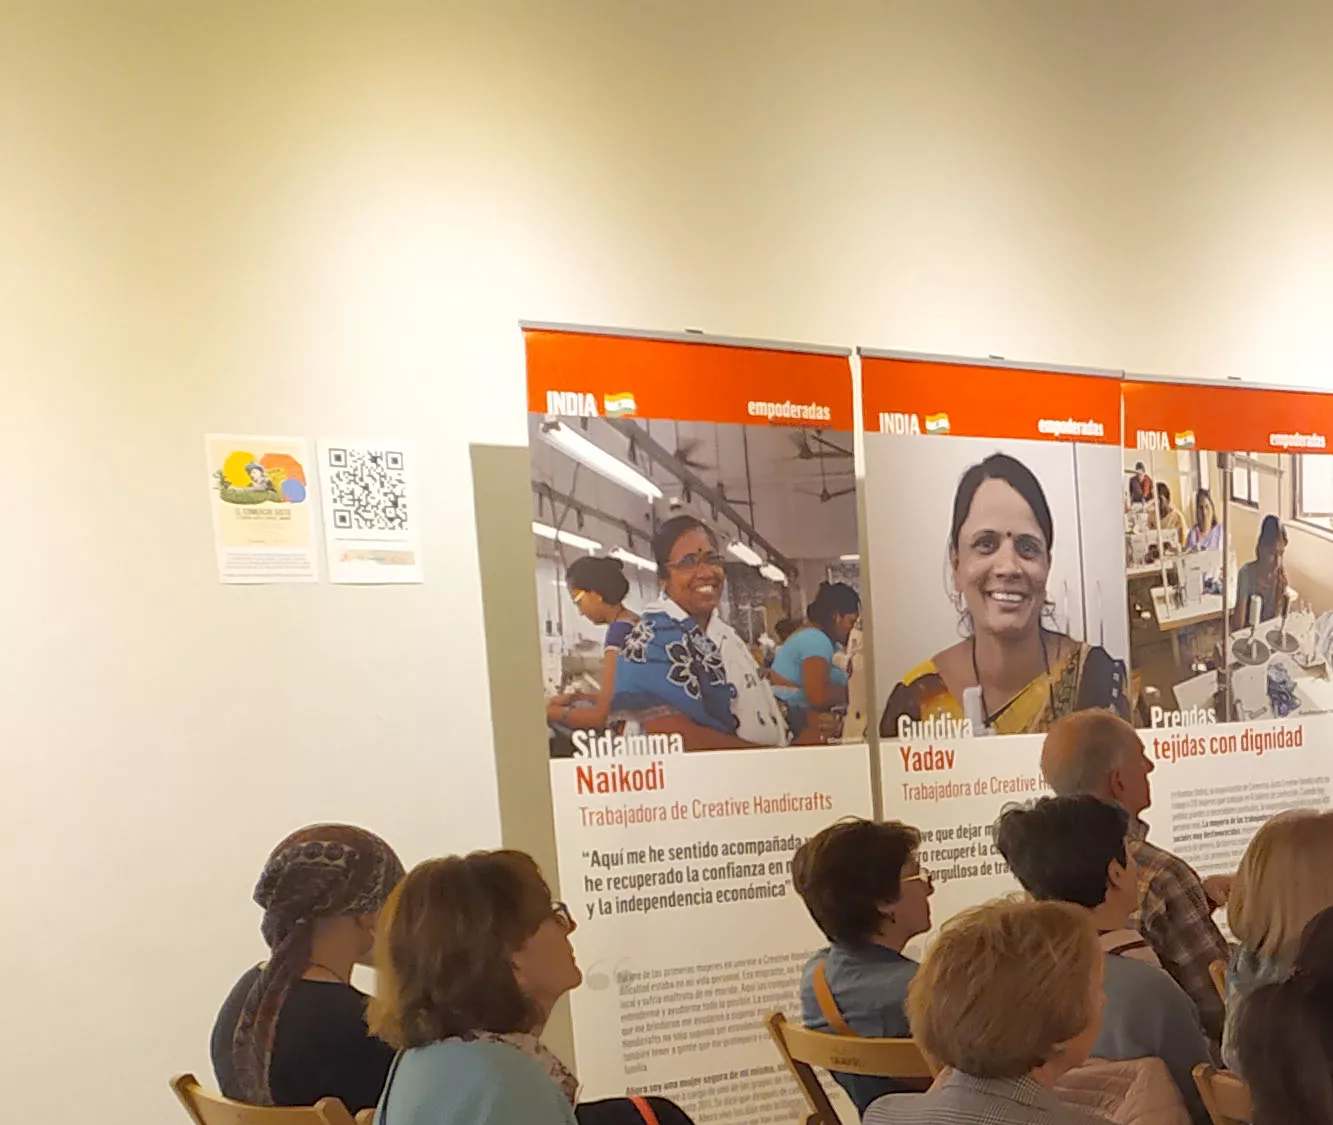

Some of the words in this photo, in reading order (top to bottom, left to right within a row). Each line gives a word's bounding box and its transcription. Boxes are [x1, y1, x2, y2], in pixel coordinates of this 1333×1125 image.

[546, 391, 598, 417] INDIA
[747, 400, 830, 420] empoderadas
[879, 412, 921, 435] INDIA
[1136, 430, 1170, 450] INDIA
[1151, 705, 1217, 729] Prendas
[571, 729, 684, 760] Sidamma
[899, 745, 955, 772] Yadav
[1153, 733, 1206, 763] tejidas
[1210, 736, 1237, 755] con
[1240, 725, 1303, 756] dignidad
[575, 761, 665, 795] Naikodi
[902, 780, 971, 803] Trabajadora
[975, 780, 988, 797] de
[990, 775, 1037, 795] Creative
[578, 802, 667, 829] Trabajadora
[670, 800, 688, 821] de
[691, 796, 750, 821] Creative
[753, 791, 833, 816] Handicrafts
[581, 847, 624, 871] “Aquí
[626, 849, 646, 866] me
[648, 845, 665, 864] he
[667, 840, 719, 862] sentido
[721, 832, 802, 857] acompañada
[584, 874, 603, 893] he
[606, 866, 684, 892] recuperado
[686, 865, 700, 884] la
[702, 860, 766, 882] confianza
[768, 860, 784, 877] en
[585, 902, 595, 921] y
[598, 897, 613, 917] la
[615, 887, 714, 915] independencia
[715, 879, 791, 904] económica”
